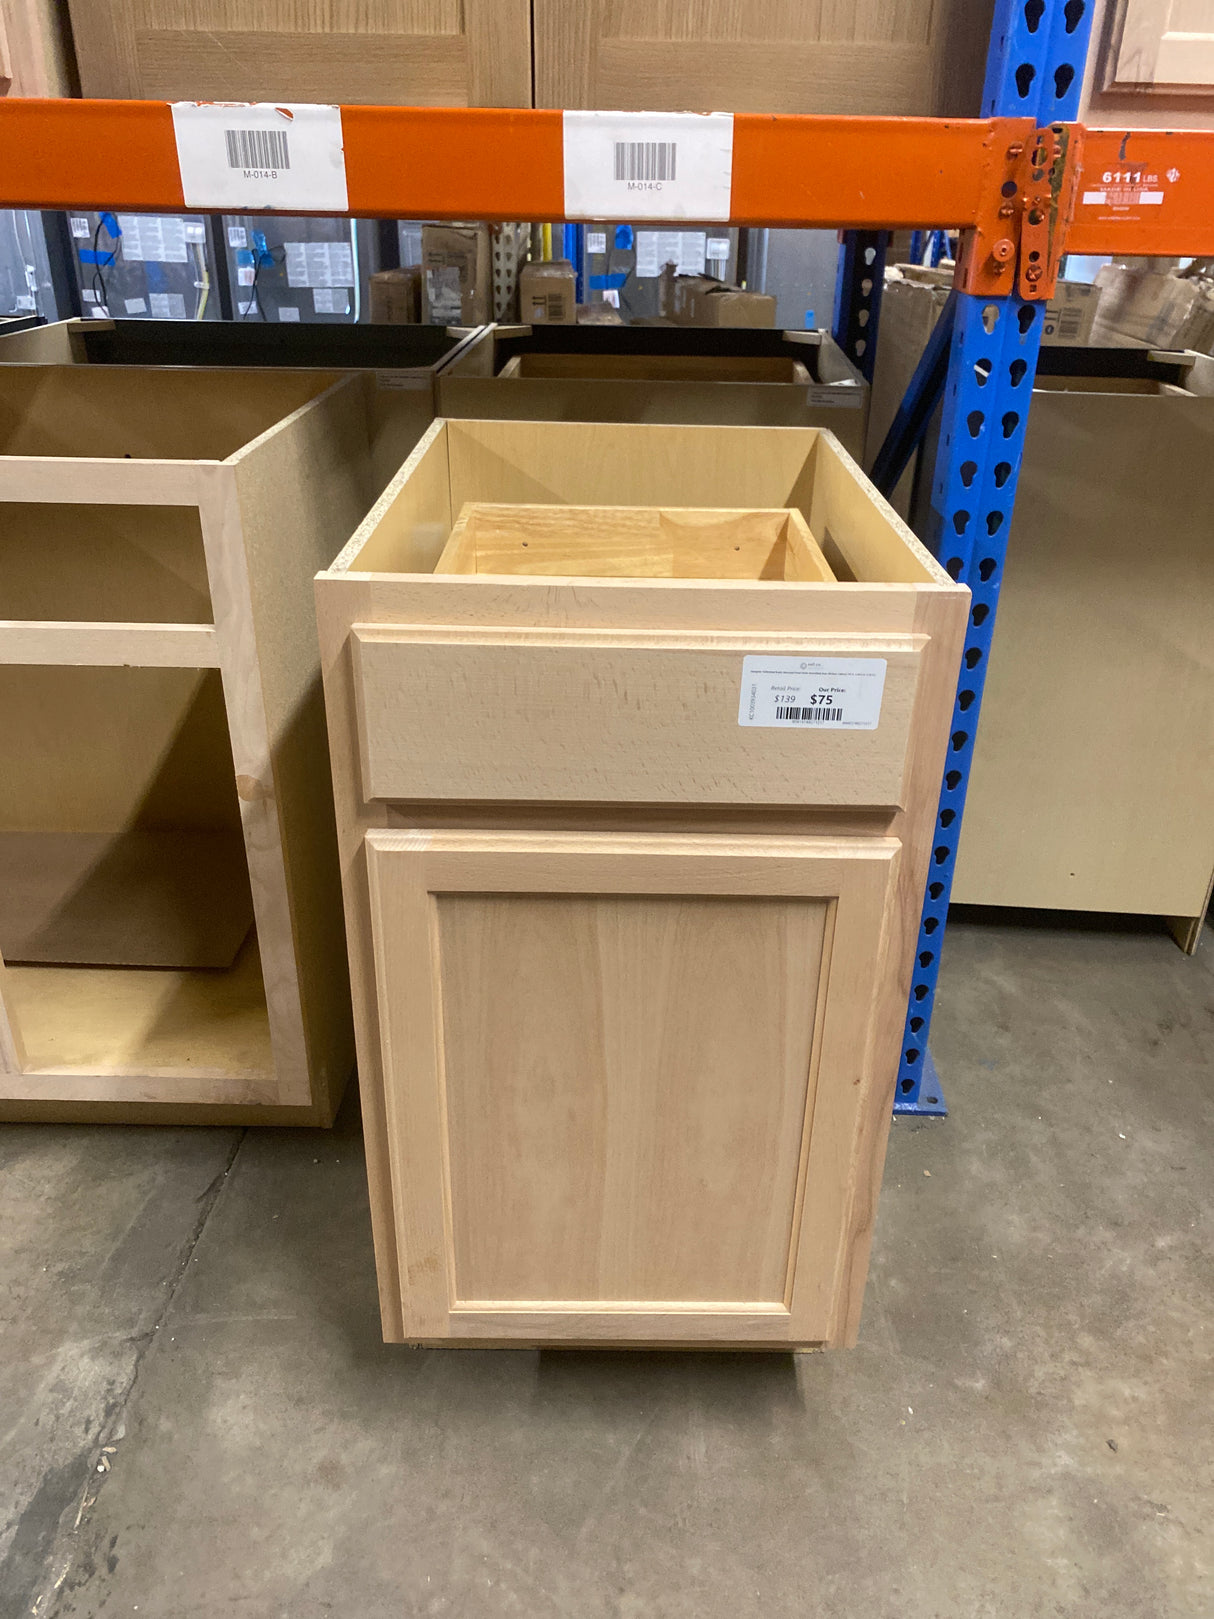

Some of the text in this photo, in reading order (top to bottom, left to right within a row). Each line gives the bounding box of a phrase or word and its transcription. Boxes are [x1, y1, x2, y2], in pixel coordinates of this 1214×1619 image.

[243, 170, 278, 179] M-014-B
[1102, 172, 1158, 183] 6111 LBS
[627, 182, 662, 191] M-014-C
[774, 694, 796, 703] $139
[810, 693, 833, 705] $75
